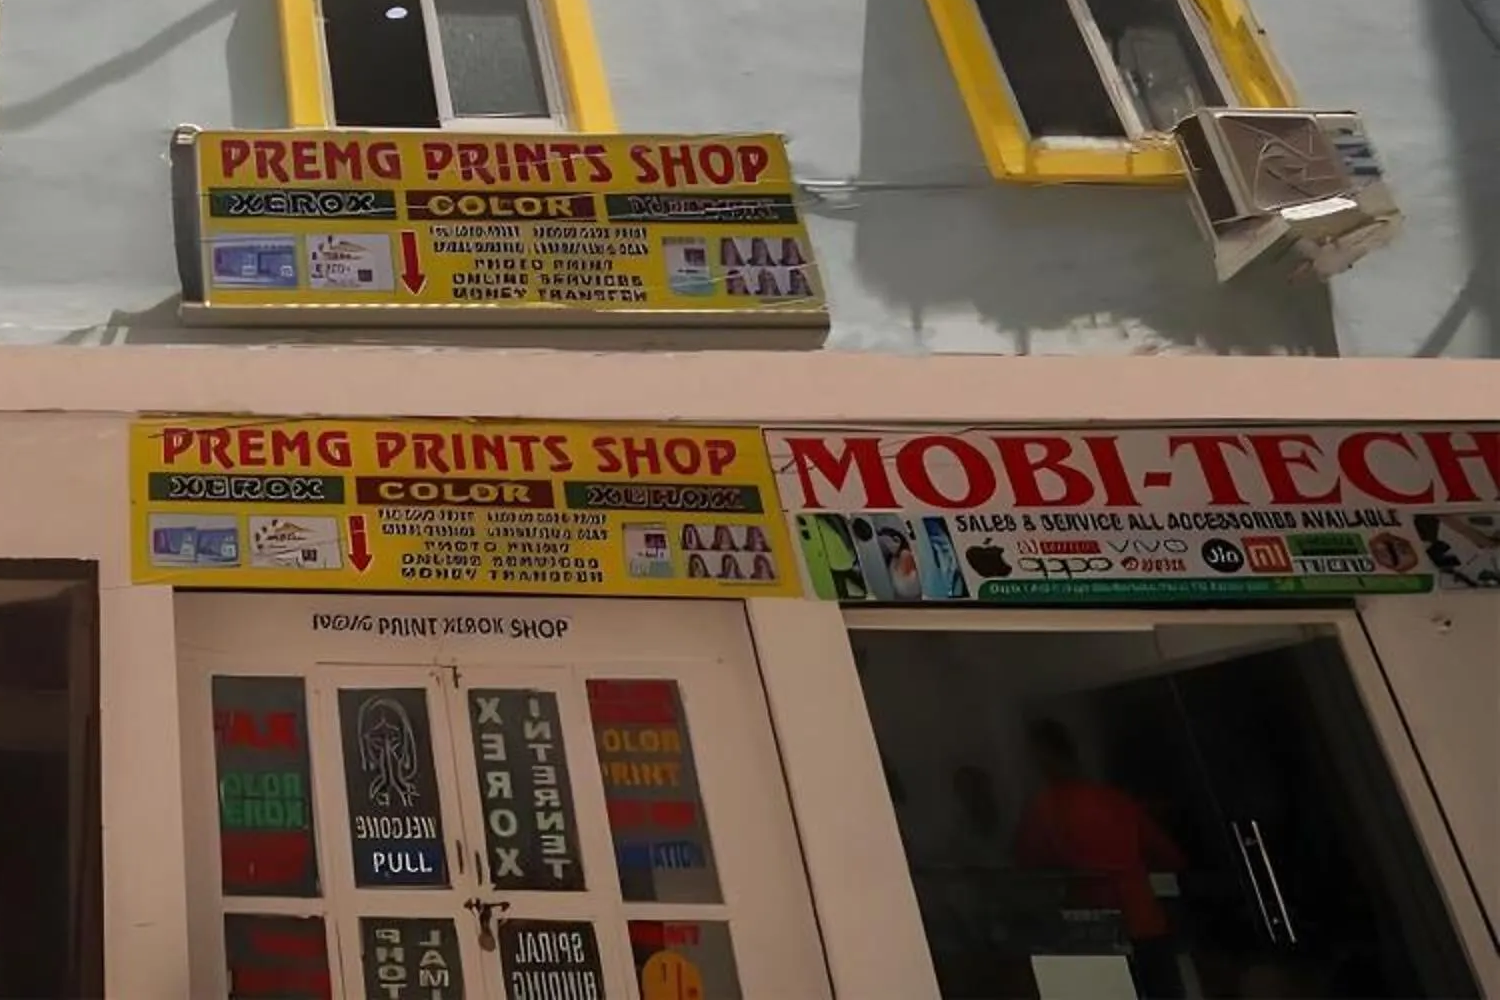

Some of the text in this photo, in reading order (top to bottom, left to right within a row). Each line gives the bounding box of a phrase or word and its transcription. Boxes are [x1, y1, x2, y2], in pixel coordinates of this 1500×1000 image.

[220, 138, 769, 188] PREMG PRINTS SHOP
[427, 194, 574, 217] COLOR
[164, 427, 737, 479] PREMG PRINTS SHOP
[785, 431, 1500, 509] MOBI-TECH
[378, 481, 532, 503] COLOR
[1129, 513, 1165, 532] ALL
[509, 618, 569, 639] SHOP
[372, 851, 433, 874] PULL
